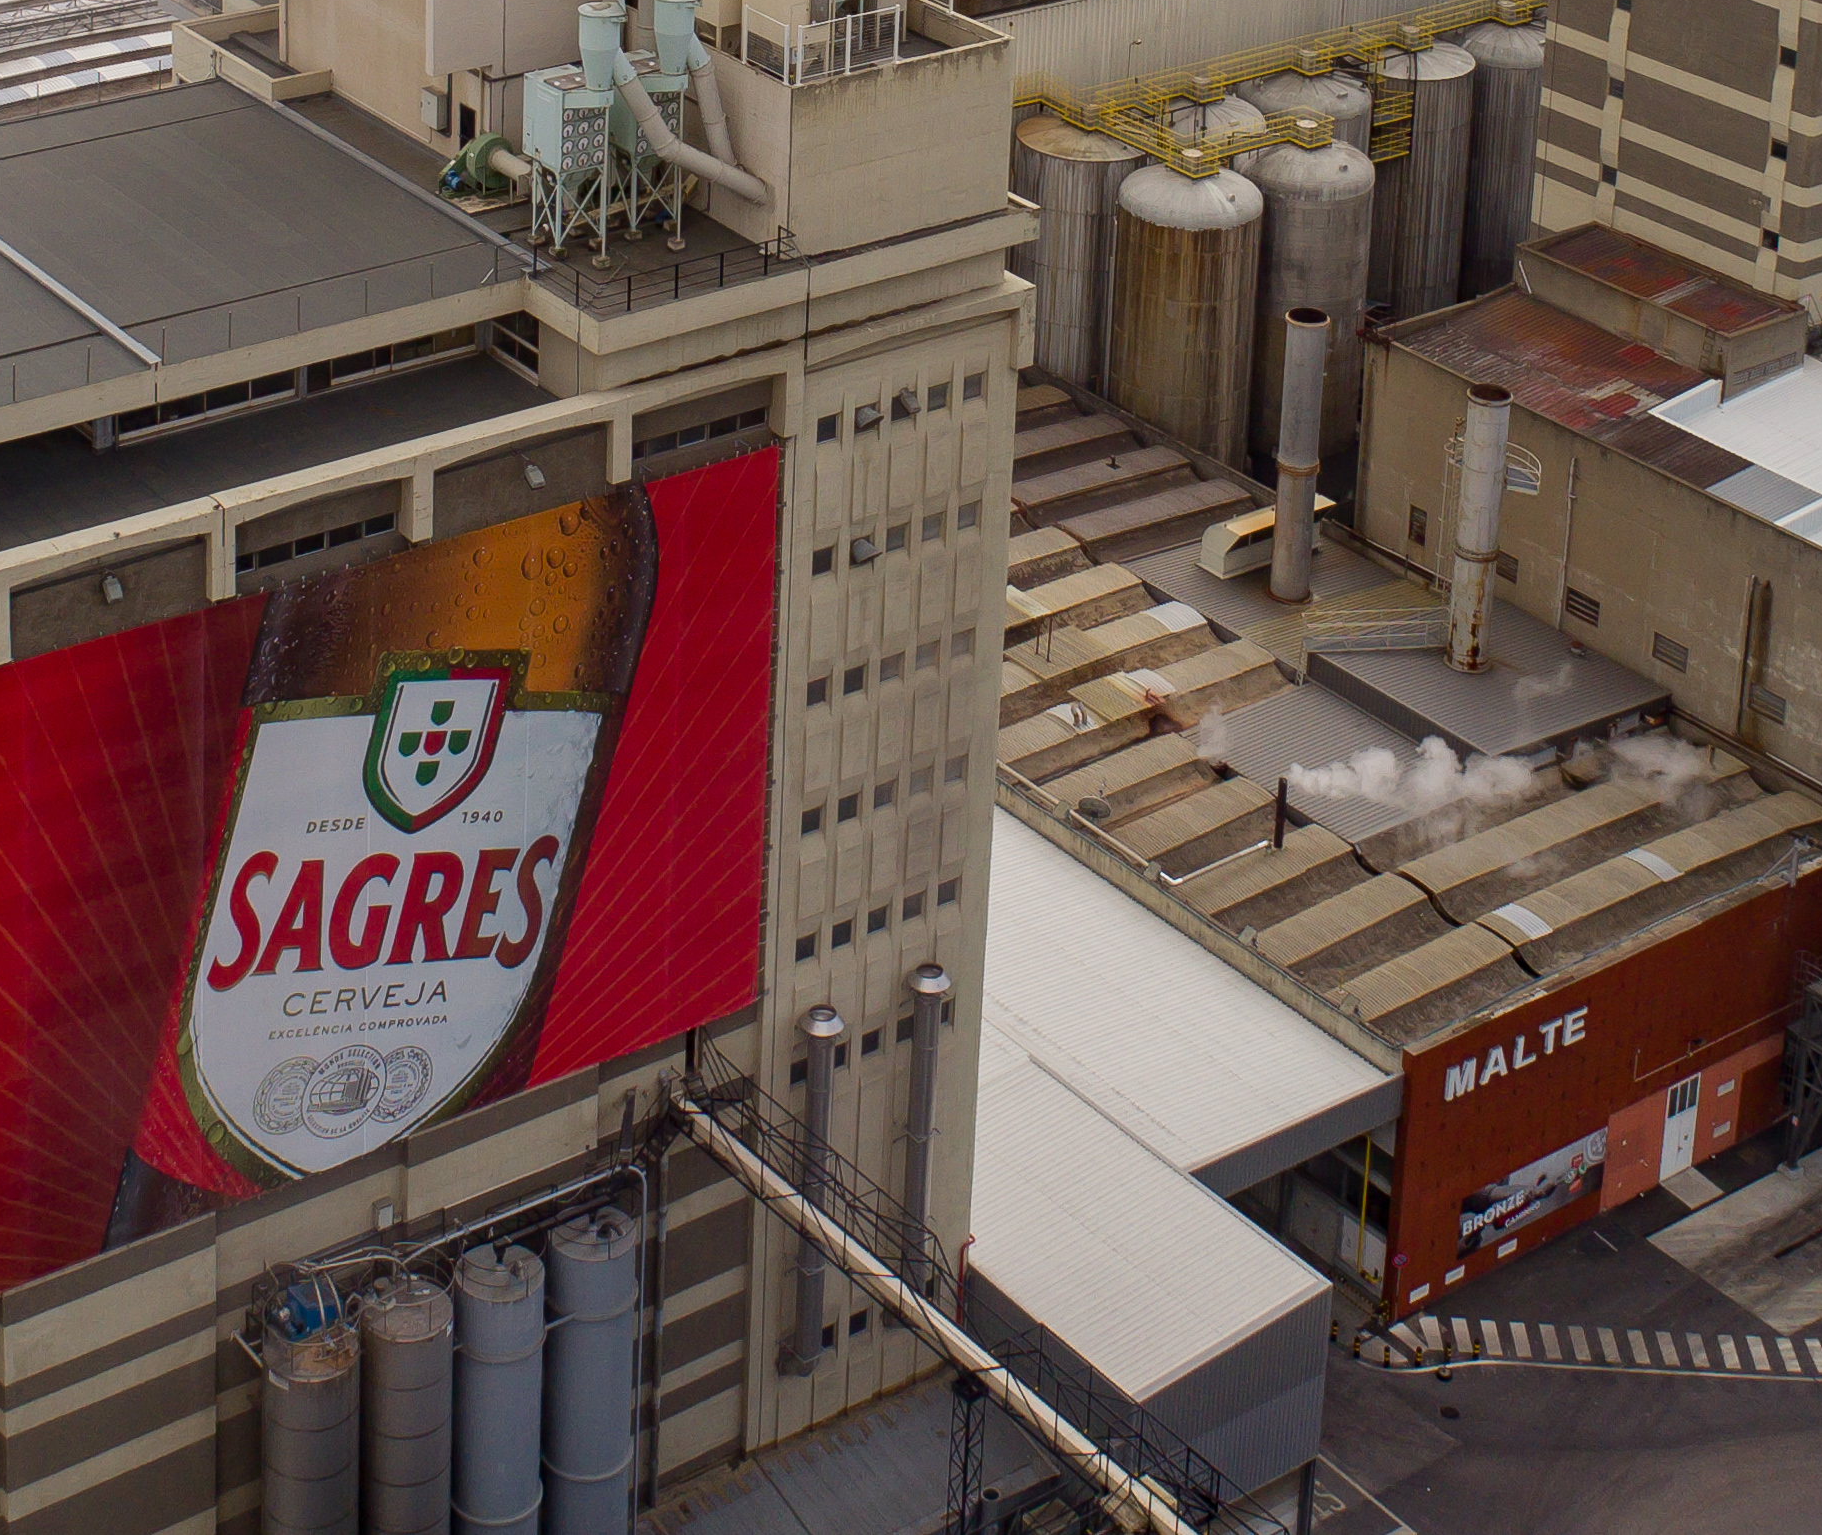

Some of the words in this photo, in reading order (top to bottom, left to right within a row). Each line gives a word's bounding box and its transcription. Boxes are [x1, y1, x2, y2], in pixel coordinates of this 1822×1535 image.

[306, 817, 366, 834] DESDE
[461, 810, 504, 824] 1940
[206, 834, 560, 991] SAGRES
[282, 979, 448, 1017] CERVEJA
[268, 1024, 353, 1040] EXCELÊNCIA
[358, 1015, 448, 1032] COMPROVADA
[1443, 1004, 1589, 1102] MALTE
[1462, 1189, 1526, 1237] BRONZE
